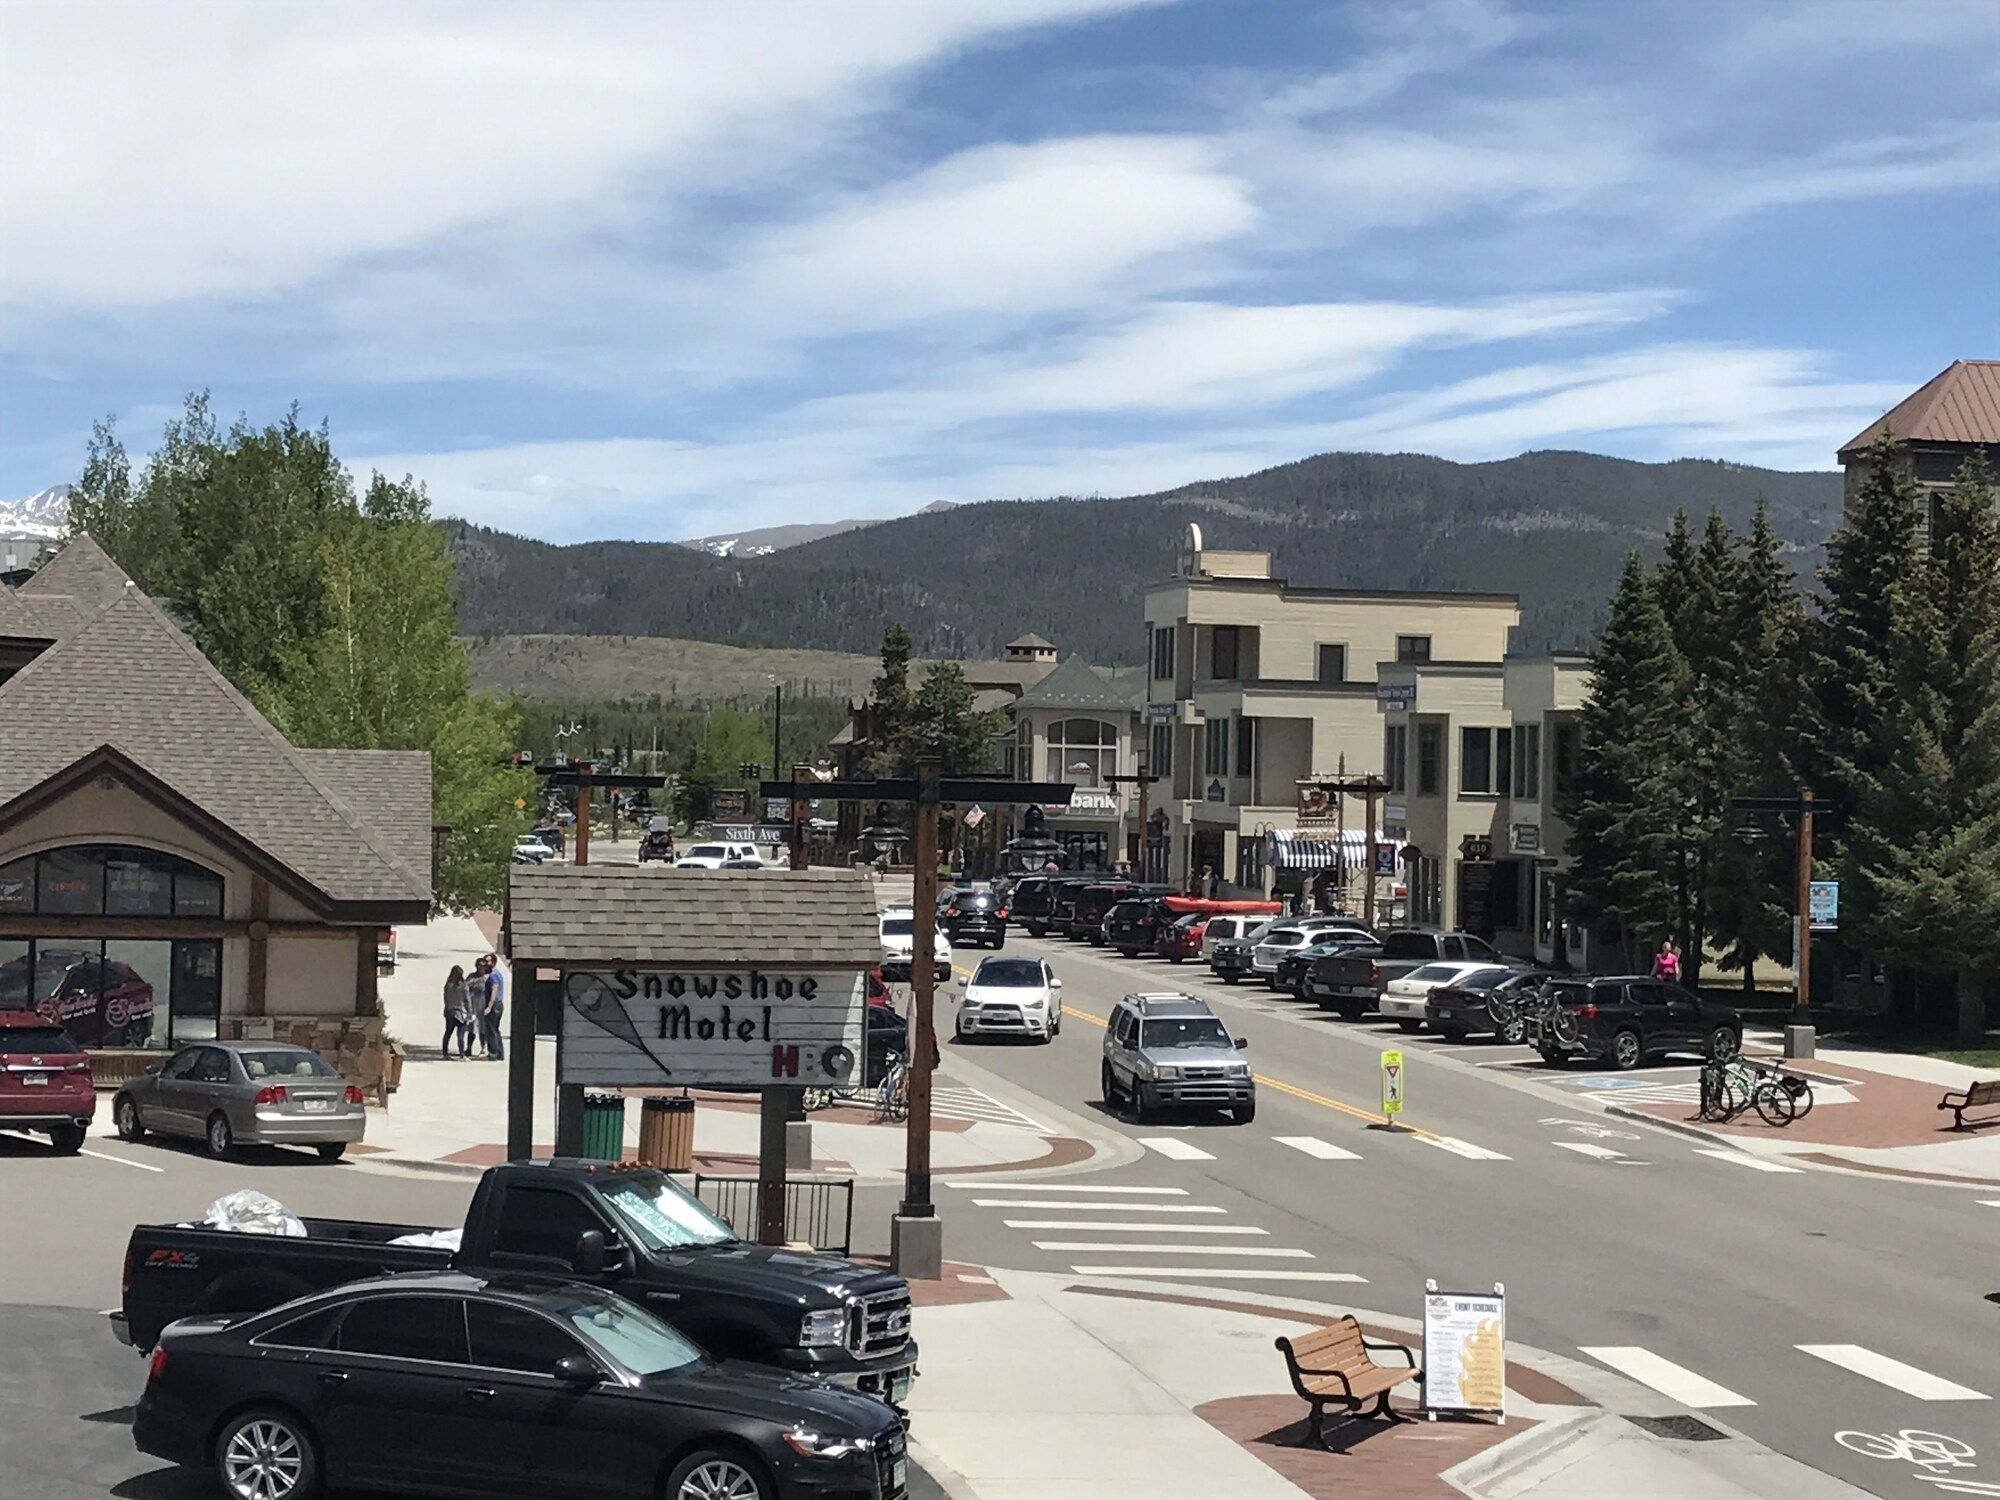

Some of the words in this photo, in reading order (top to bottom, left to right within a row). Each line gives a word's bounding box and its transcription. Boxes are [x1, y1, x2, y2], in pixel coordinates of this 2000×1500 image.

[725, 827, 755, 841] Sixth
[759, 828, 780, 841] Ave
[614, 968, 818, 1000] Snowshoe
[658, 1003, 771, 1042] Motel
[771, 1044, 855, 1078] HBO
[1454, 1302, 1471, 1312] EVENT
